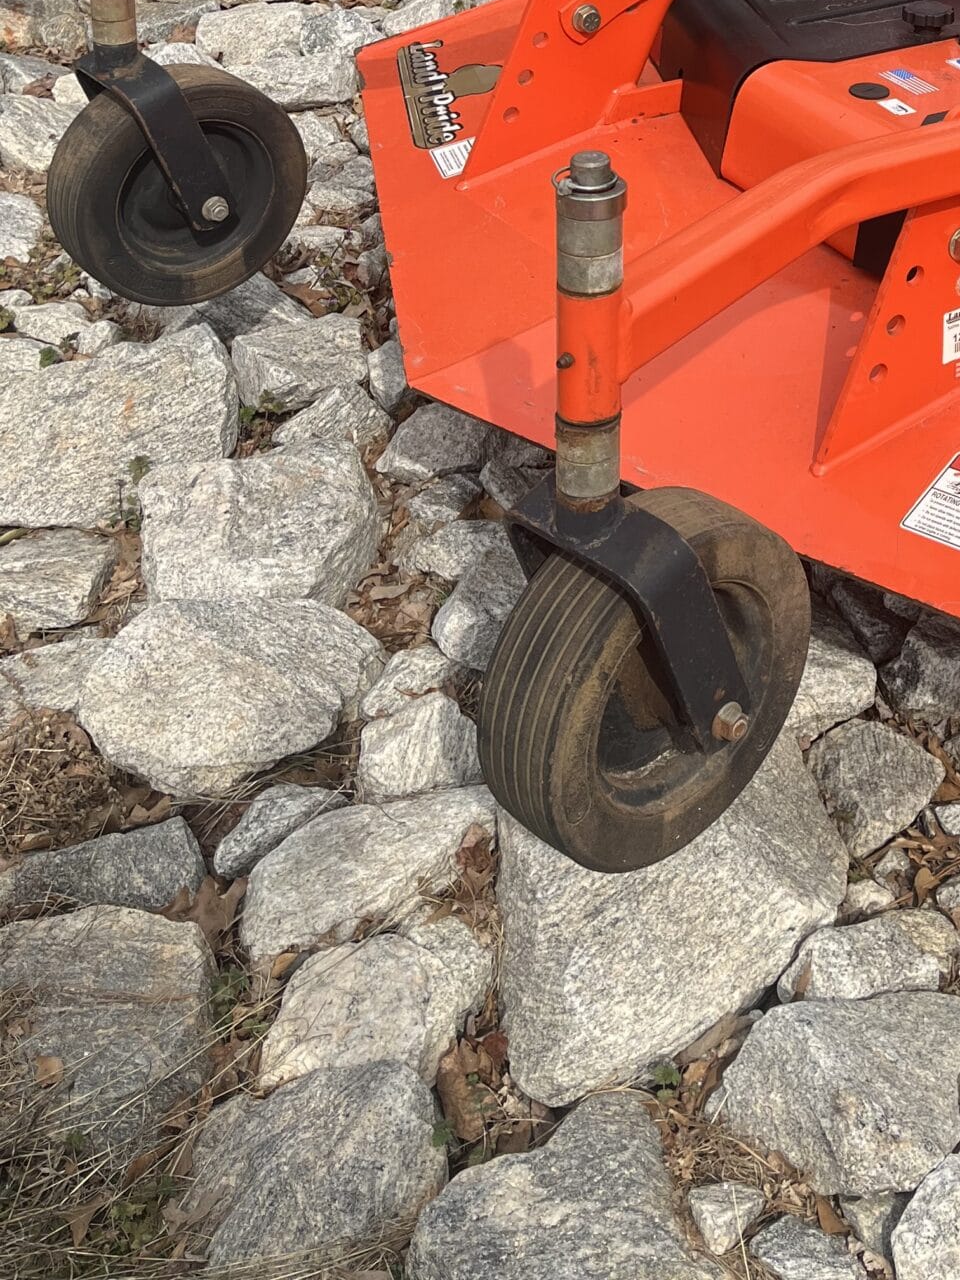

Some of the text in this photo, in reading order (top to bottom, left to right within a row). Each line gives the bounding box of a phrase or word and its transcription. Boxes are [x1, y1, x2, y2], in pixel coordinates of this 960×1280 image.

[408, 39, 450, 84] Land
[418, 90, 464, 145] Pride
[931, 491, 960, 508] ROTATING
